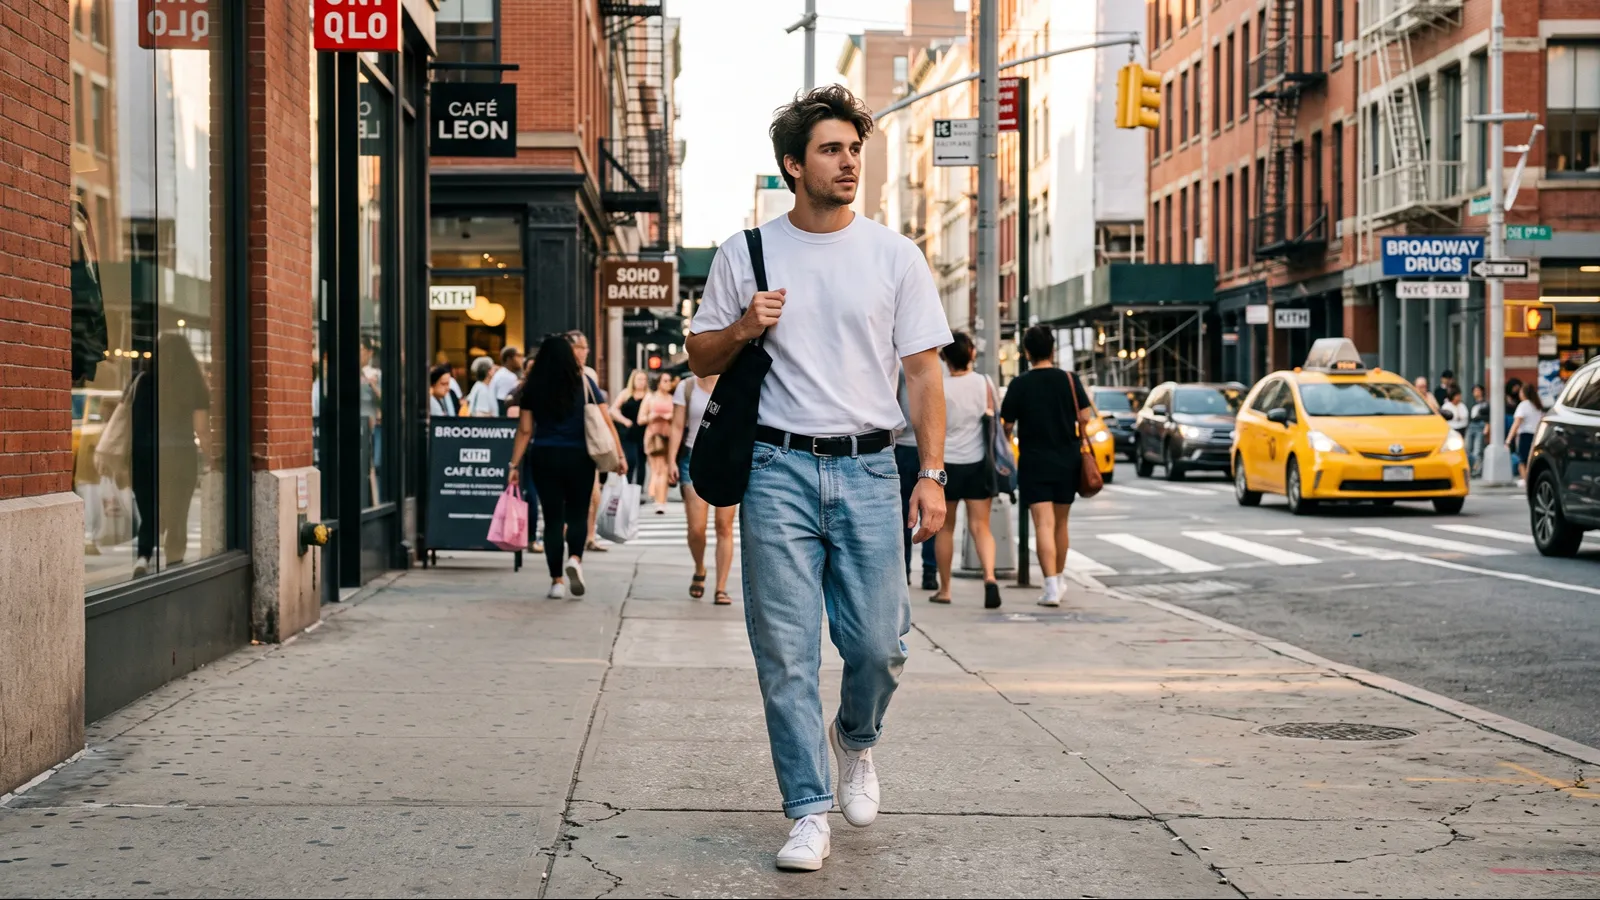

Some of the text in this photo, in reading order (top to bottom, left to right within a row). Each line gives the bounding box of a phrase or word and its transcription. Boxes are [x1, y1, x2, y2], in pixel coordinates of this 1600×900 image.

[324, 11, 388, 44] QLO
[448, 98, 498, 117] CAFÉ
[438, 120, 508, 140] LEON
[1386, 240, 1480, 256] BROADWAY
[1405, 256, 1463, 272] DRUGS
[616, 267, 660, 282] SOHO
[608, 284, 669, 299] BAKERY
[1403, 284, 1462, 294] NYC TAXI
[431, 291, 472, 304] KITH
[1278, 312, 1308, 324] KITH
[462, 451, 488, 460] KITH
[444, 465, 505, 478] CAFÉ LEON
